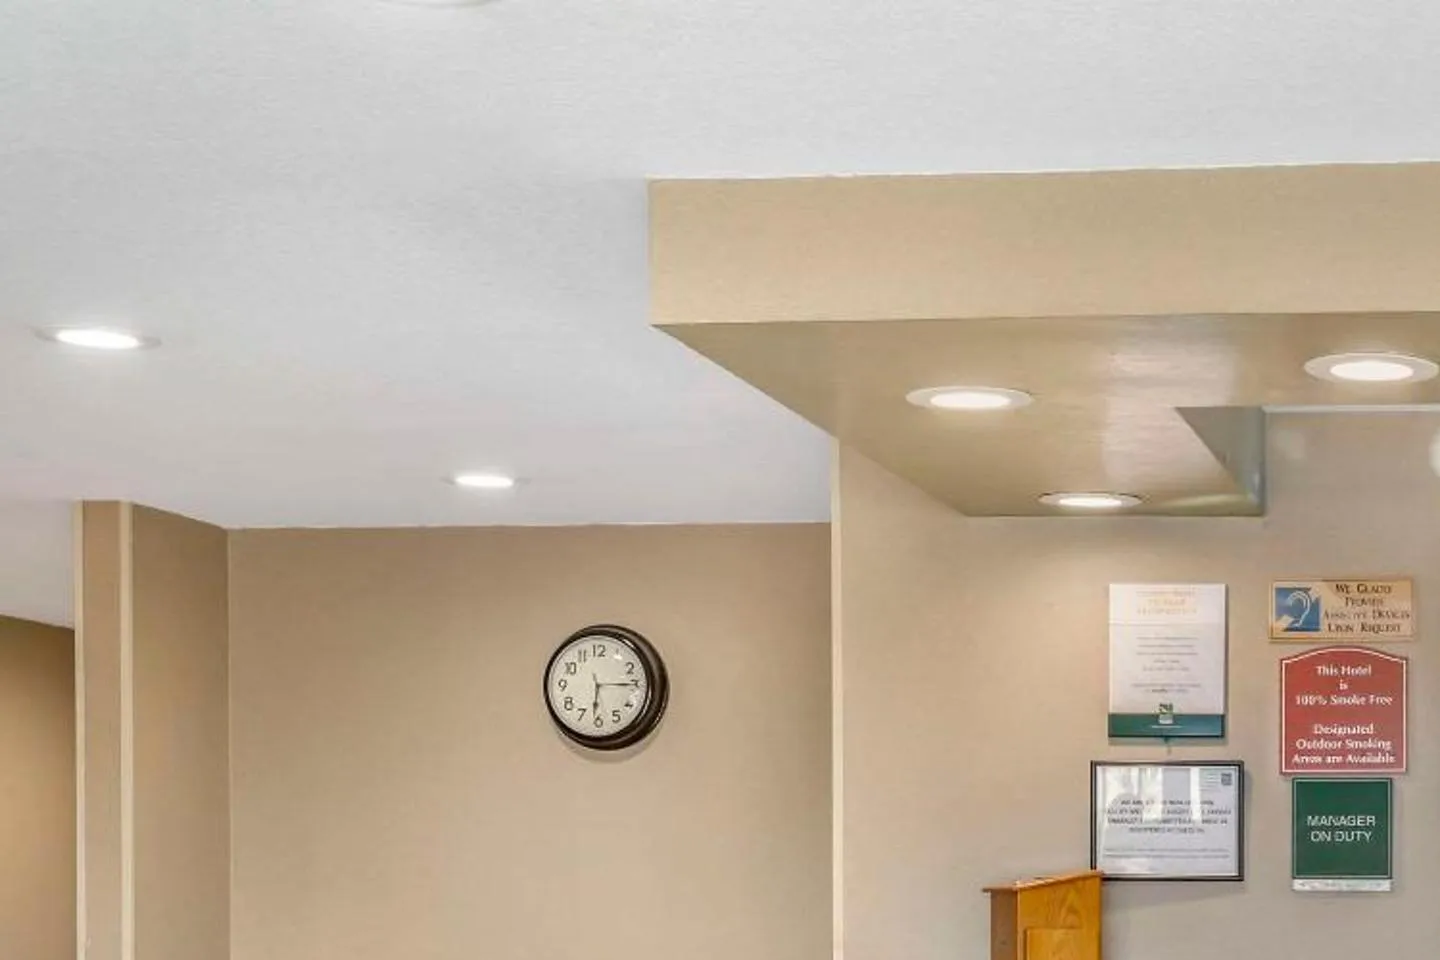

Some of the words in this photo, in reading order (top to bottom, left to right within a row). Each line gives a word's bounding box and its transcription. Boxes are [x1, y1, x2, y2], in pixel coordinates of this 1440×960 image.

[578, 649, 587, 662] 11
[592, 644, 606, 657] 12
[564, 662, 577, 675] 10
[625, 662, 635, 675] 2
[1316, 665, 1339, 676] This
[1341, 665, 1372, 676] Hotel
[558, 679, 567, 692] 9
[1340, 679, 1348, 690] is
[564, 697, 573, 711] 8
[1296, 695, 1327, 705] 100%
[1330, 695, 1366, 705] Smoke
[1369, 694, 1393, 705] Free
[577, 708, 587, 721] 7
[611, 709, 621, 723] 5
[593, 715, 603, 728] 6
[1314, 724, 1374, 738] Designated
[1296, 739, 1342, 750] Outdoor
[1346, 739, 1392, 752] Smoking
[1292, 754, 1322, 764] Areas
[1326, 756, 1342, 764] are
[1346, 753, 1396, 764] Available
[1307, 815, 1376, 827] MANAGER
[1310, 831, 1332, 842] ON
[1335, 831, 1373, 842] DUTY
